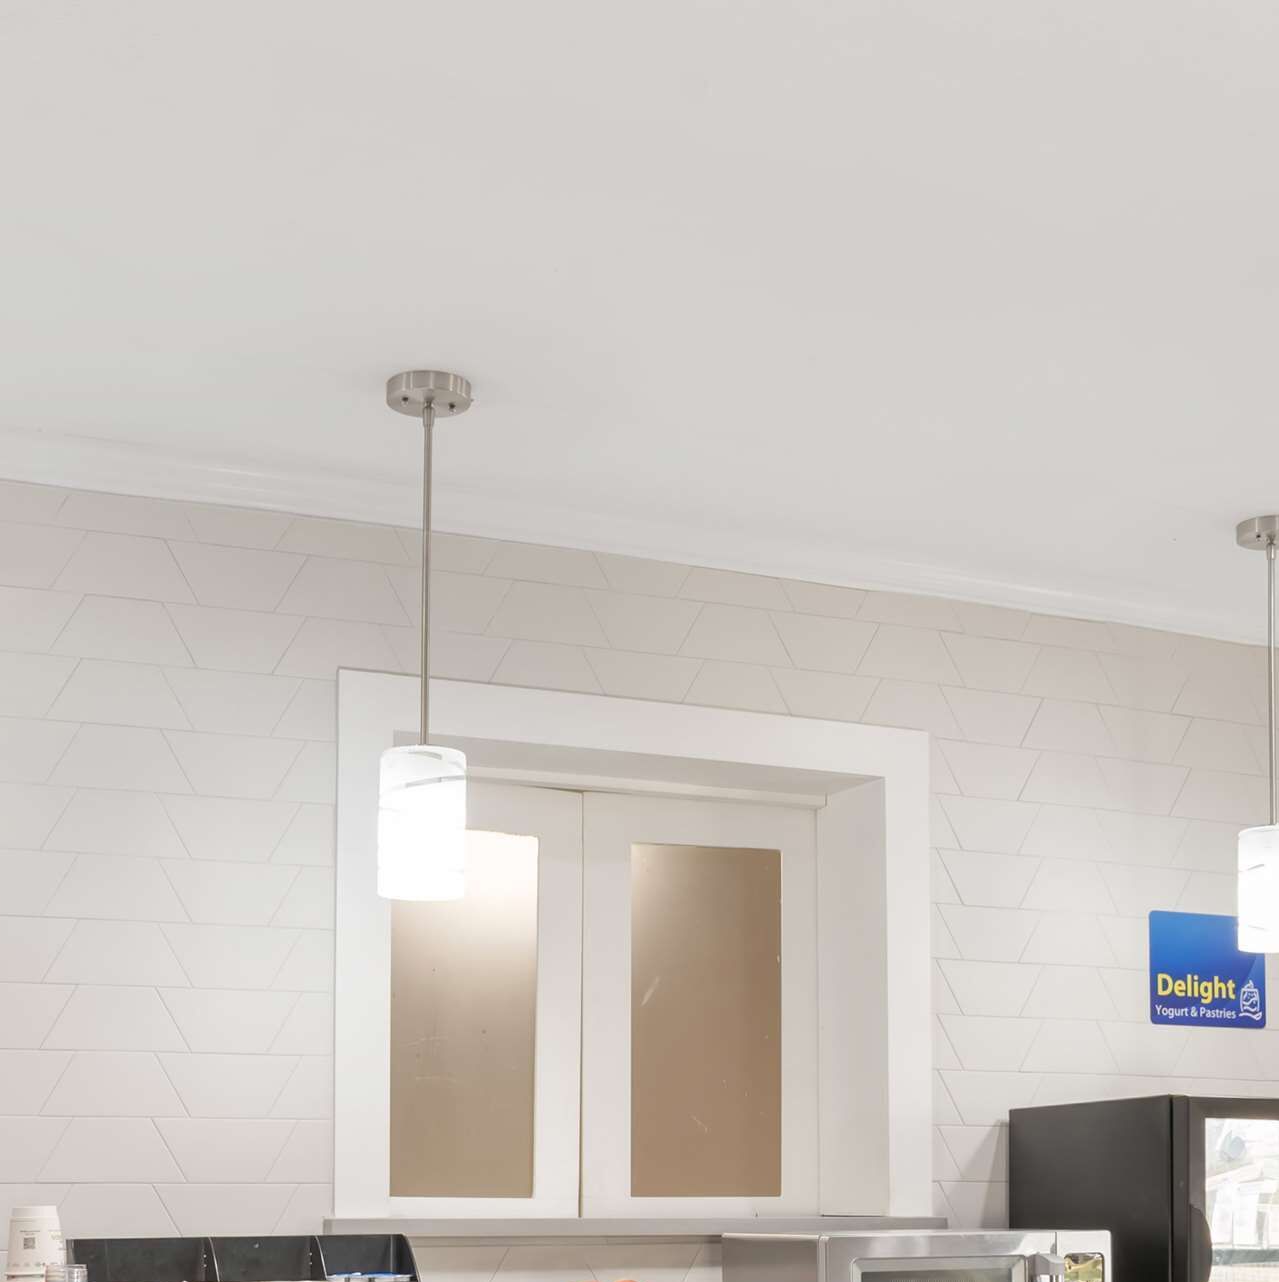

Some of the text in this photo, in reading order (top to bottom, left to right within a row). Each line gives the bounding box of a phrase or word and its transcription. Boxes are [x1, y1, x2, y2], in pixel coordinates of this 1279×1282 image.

[1156, 973, 1236, 1004] Delight
[1155, 1004, 1237, 1020] Yogurt & Pastries
